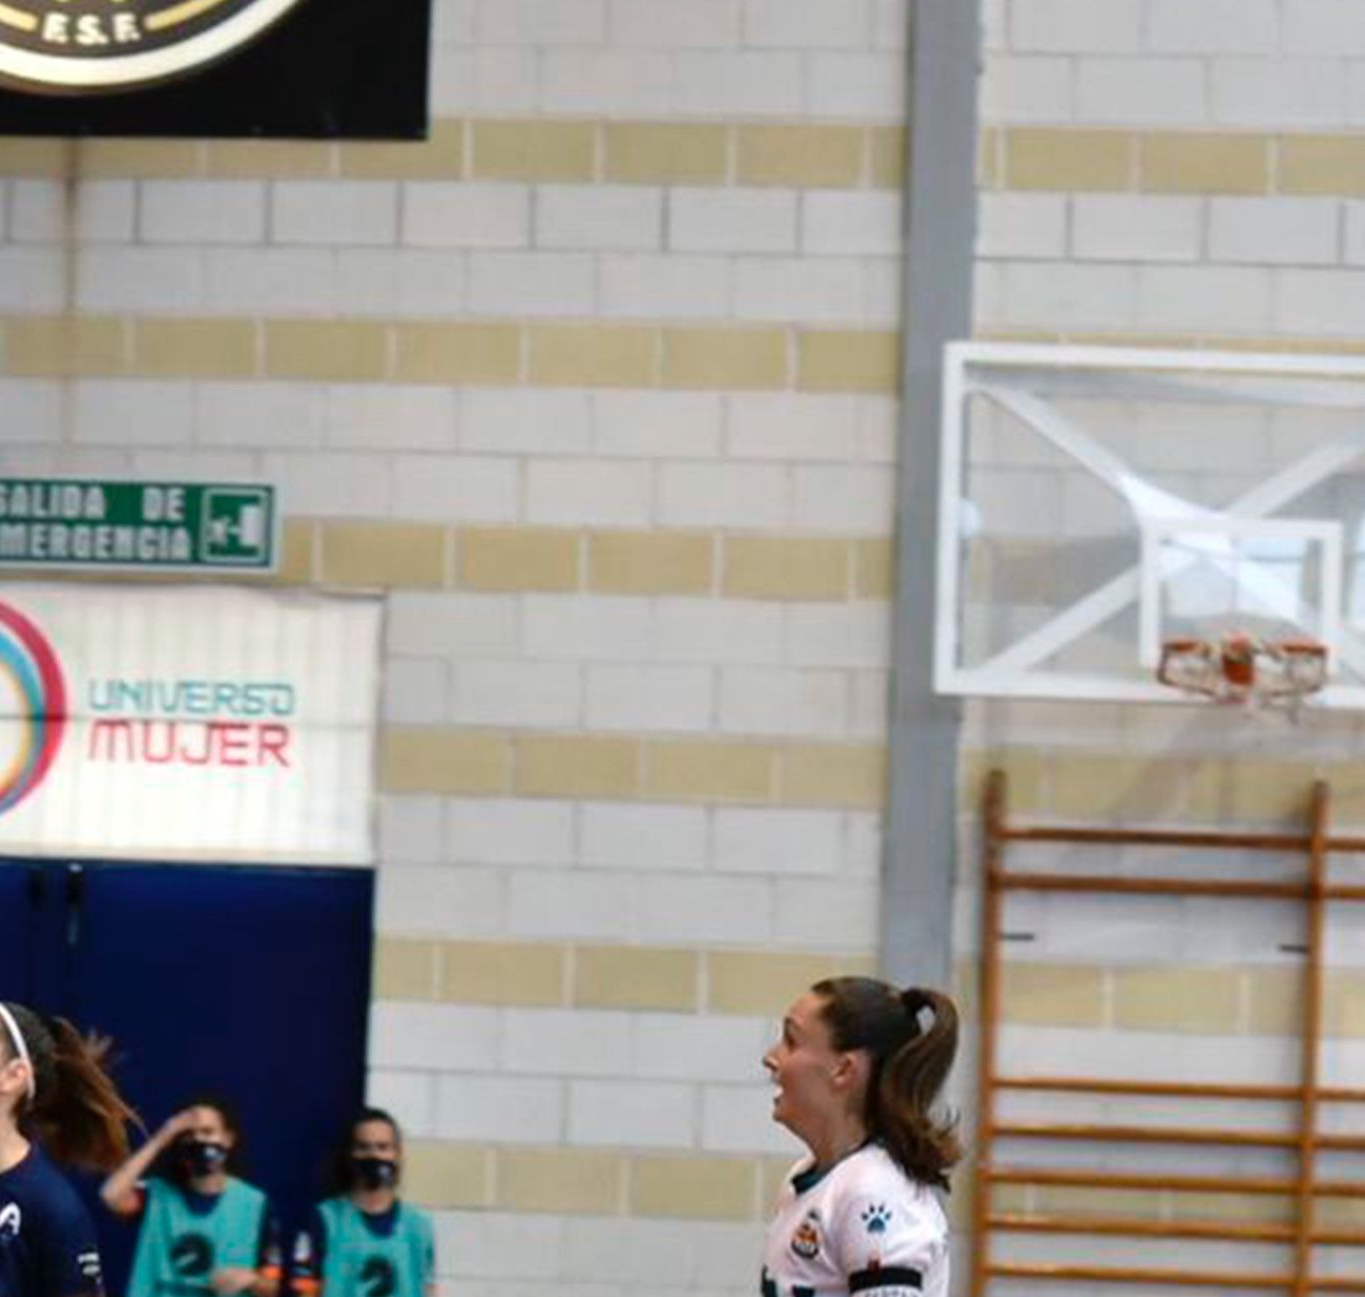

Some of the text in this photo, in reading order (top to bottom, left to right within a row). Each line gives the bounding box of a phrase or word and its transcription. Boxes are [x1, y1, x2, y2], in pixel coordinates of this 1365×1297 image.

[142, 486, 186, 521] DE
[88, 679, 295, 717] UNIVERSO
[87, 719, 290, 768] MUJER
